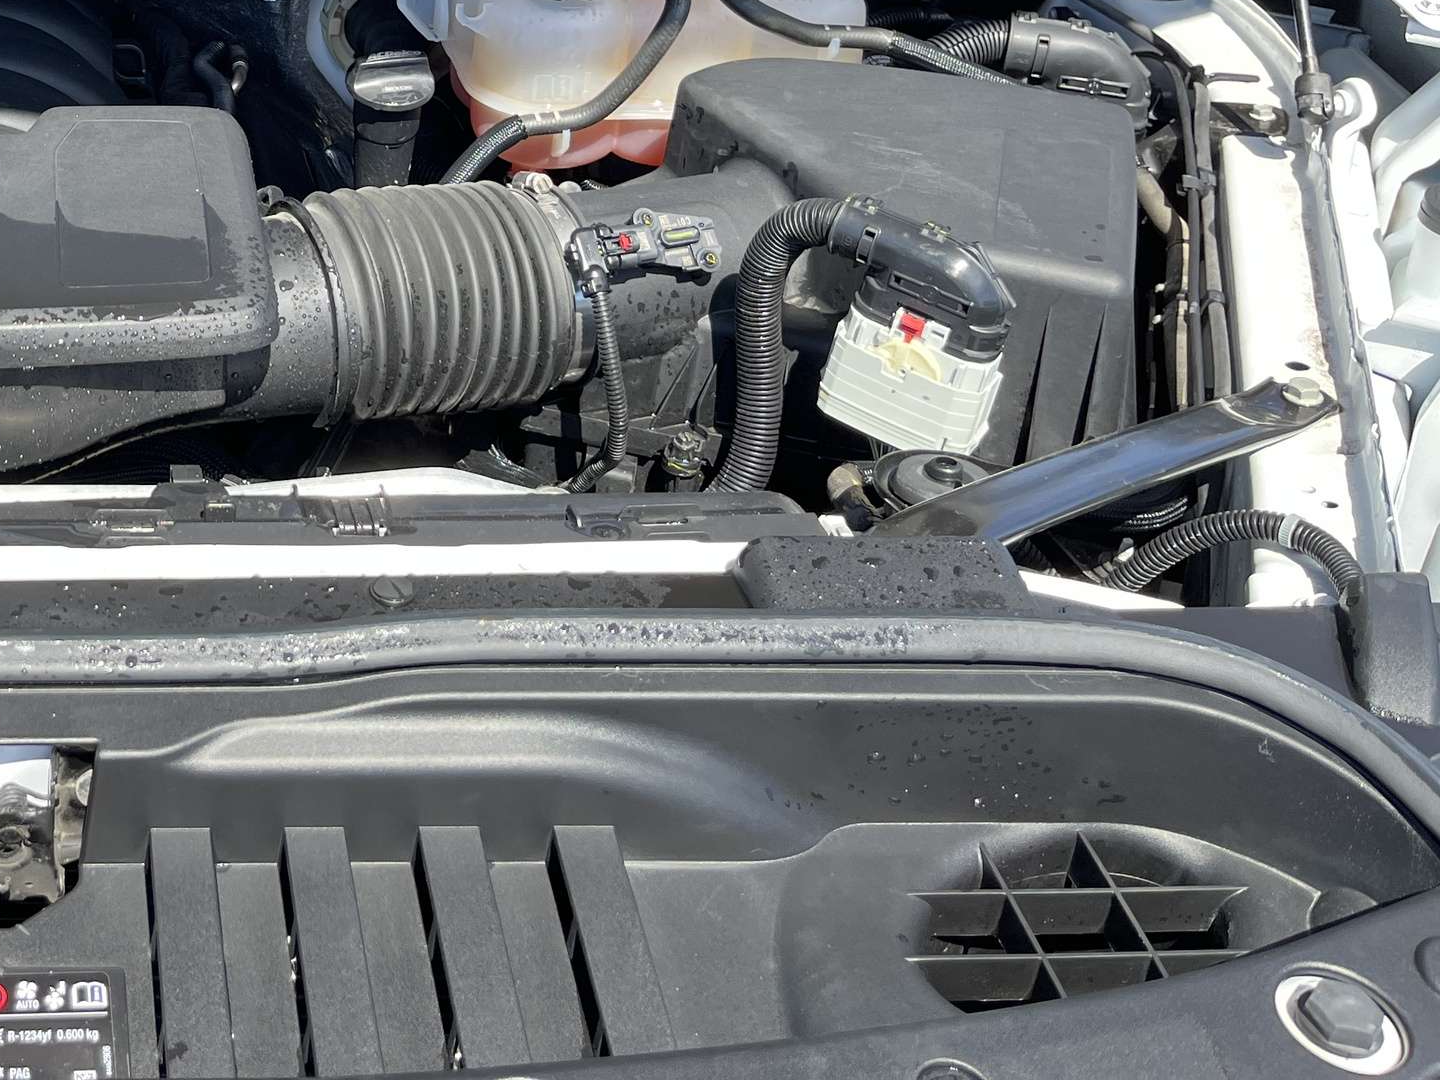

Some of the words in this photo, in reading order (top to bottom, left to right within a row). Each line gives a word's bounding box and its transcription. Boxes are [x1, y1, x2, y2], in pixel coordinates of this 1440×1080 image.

[15, 1000, 40, 1009] AUTO
[7, 1029, 52, 1043] R-1234yf
[56, 1028, 84, 1041] 0.600
[86, 1028, 99, 1041] kg
[9, 1067, 31, 1080] PAG
